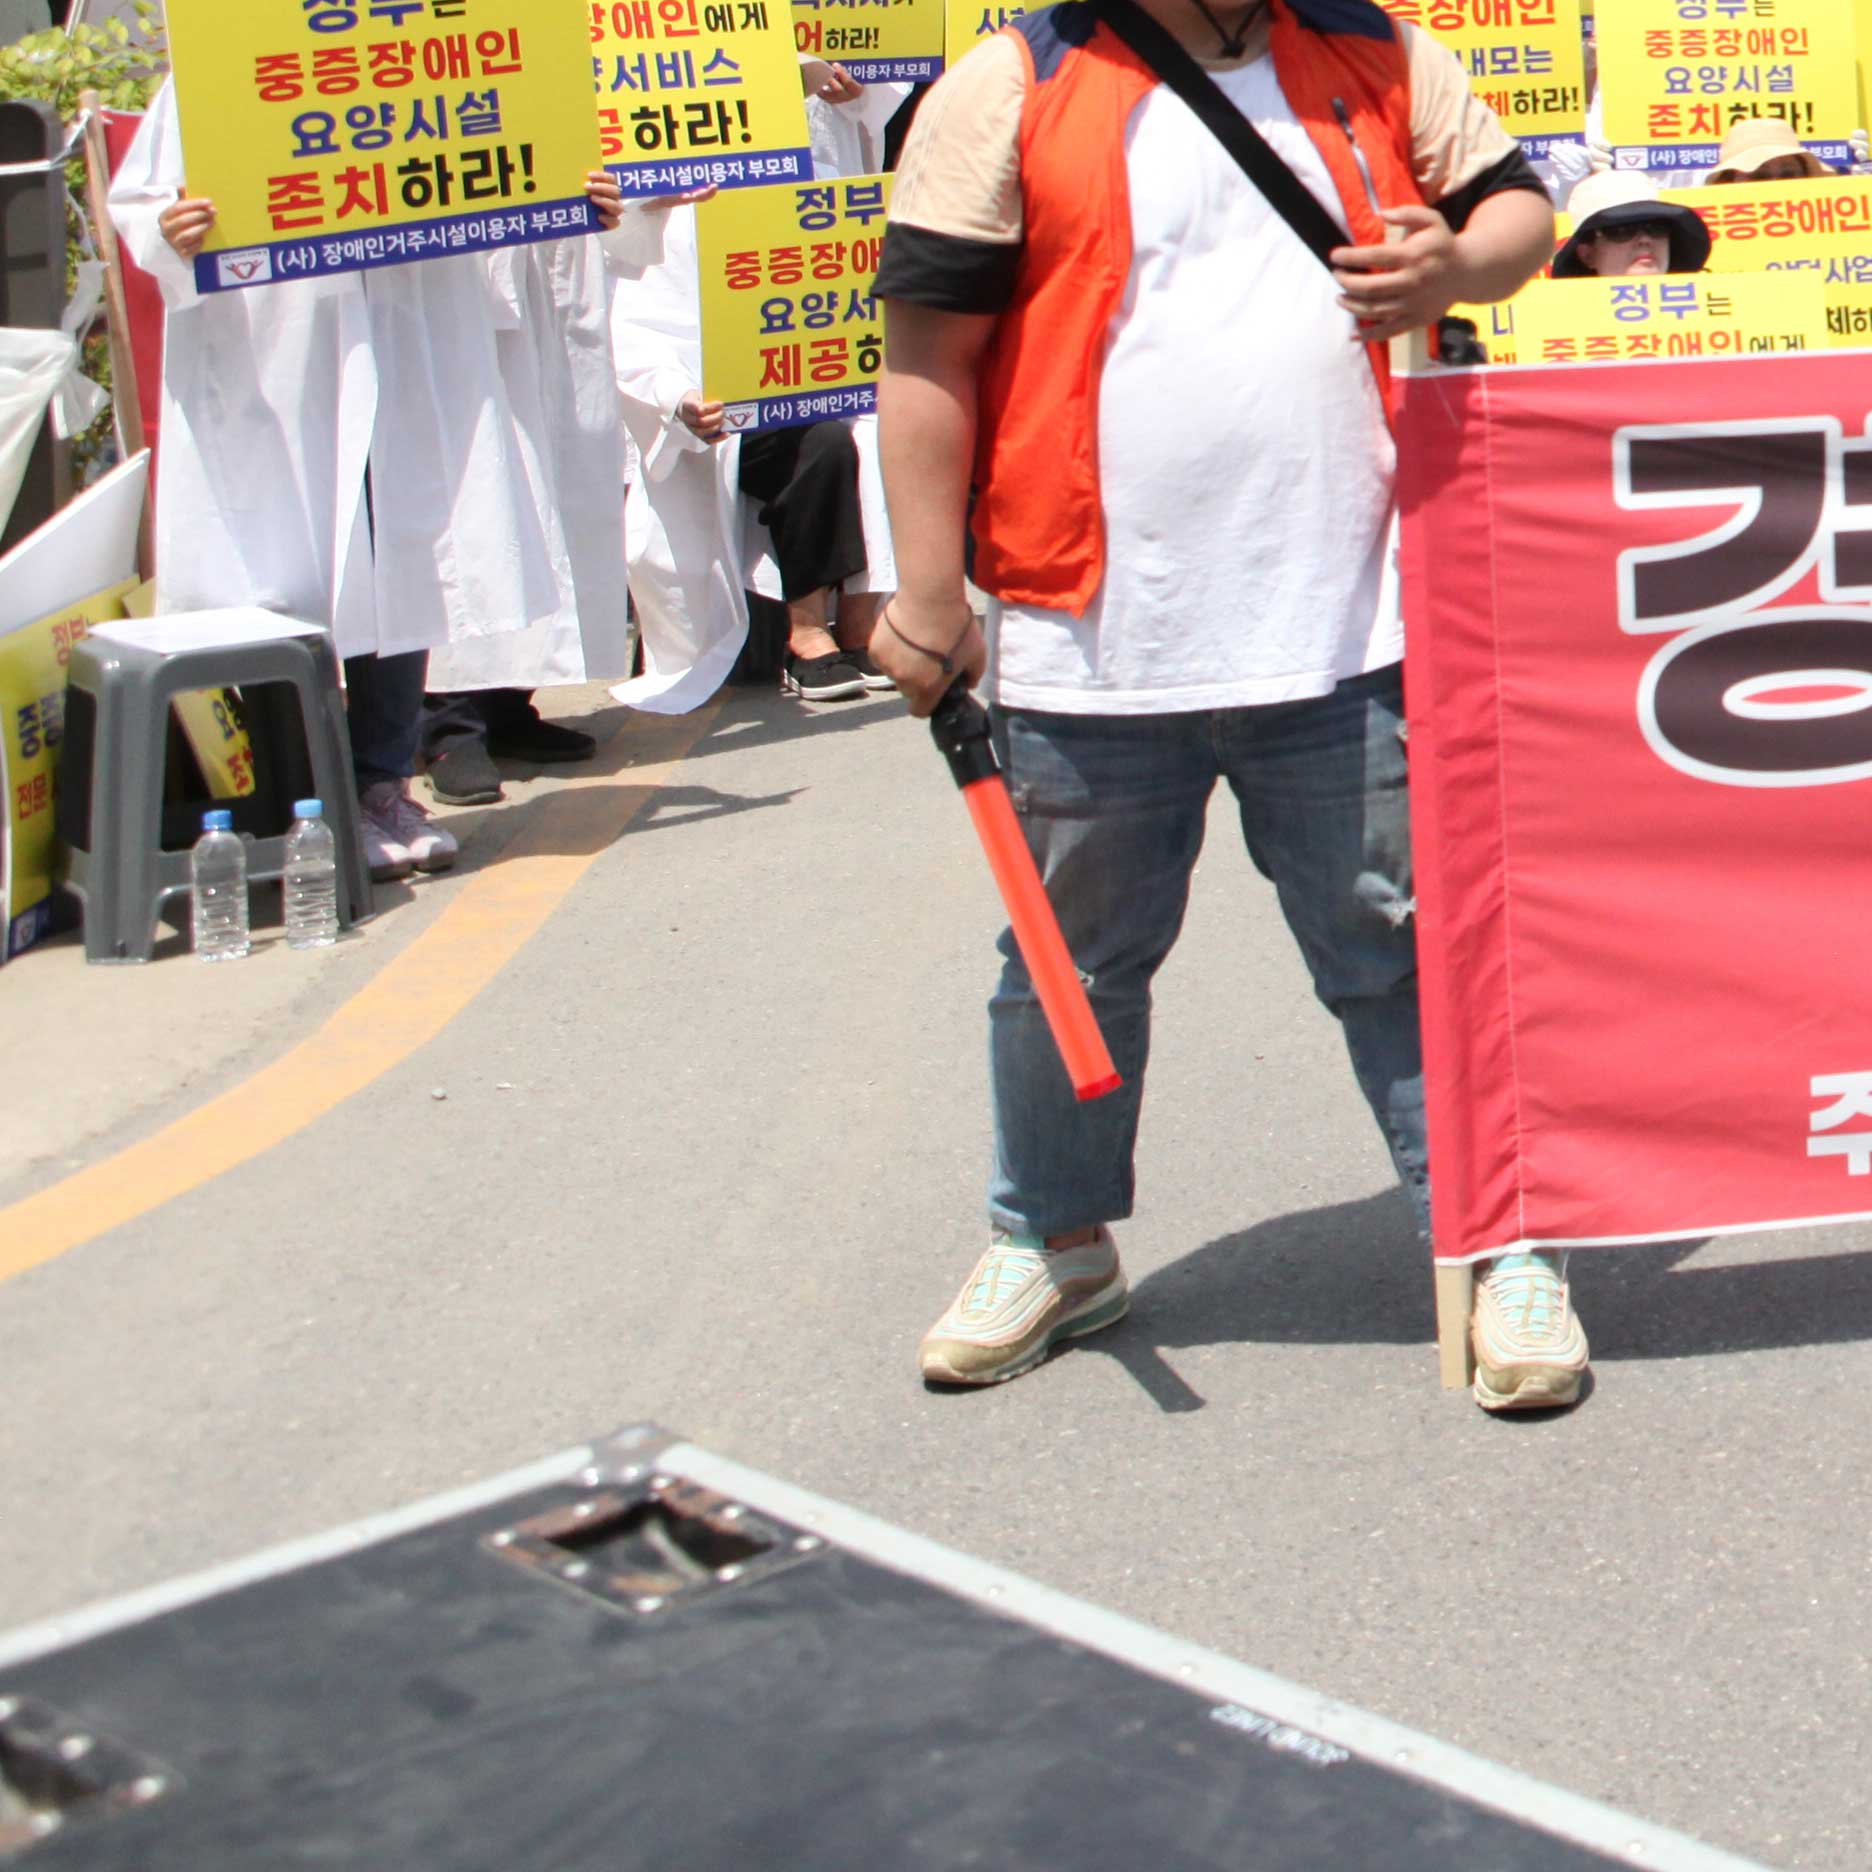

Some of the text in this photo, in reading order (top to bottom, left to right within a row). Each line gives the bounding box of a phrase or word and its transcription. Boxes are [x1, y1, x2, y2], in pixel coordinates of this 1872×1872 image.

[255, 28, 522, 102] 중증장애인
[1645, 28, 1809, 58] 중증장애인
[291, 88, 502, 158] 요양시설
[266, 143, 537, 231] 존치하라!
[322, 215, 527, 266] 장애인거주시설이용자
